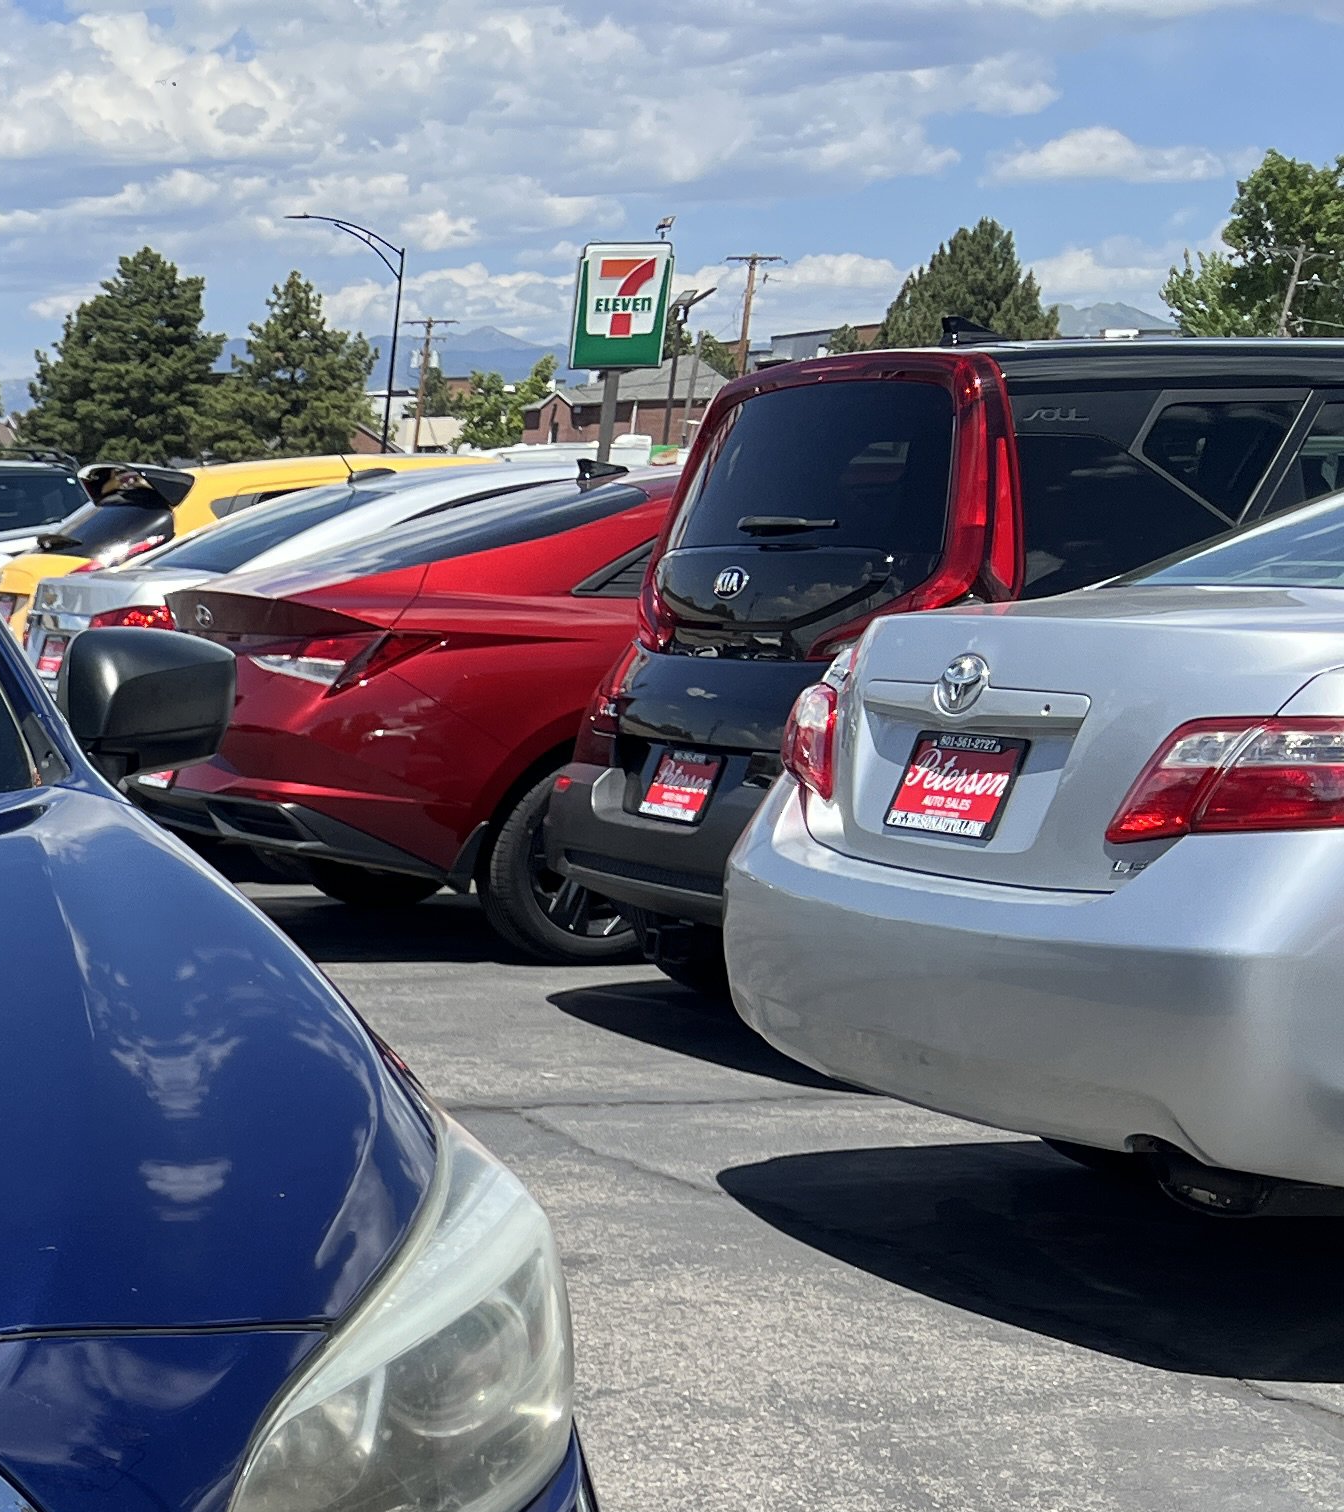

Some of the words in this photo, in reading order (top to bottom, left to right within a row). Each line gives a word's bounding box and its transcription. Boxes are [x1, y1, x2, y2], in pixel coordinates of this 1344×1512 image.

[600, 257, 657, 336] 7
[716, 572, 740, 592] KIA
[904, 748, 1010, 798] Peterson
